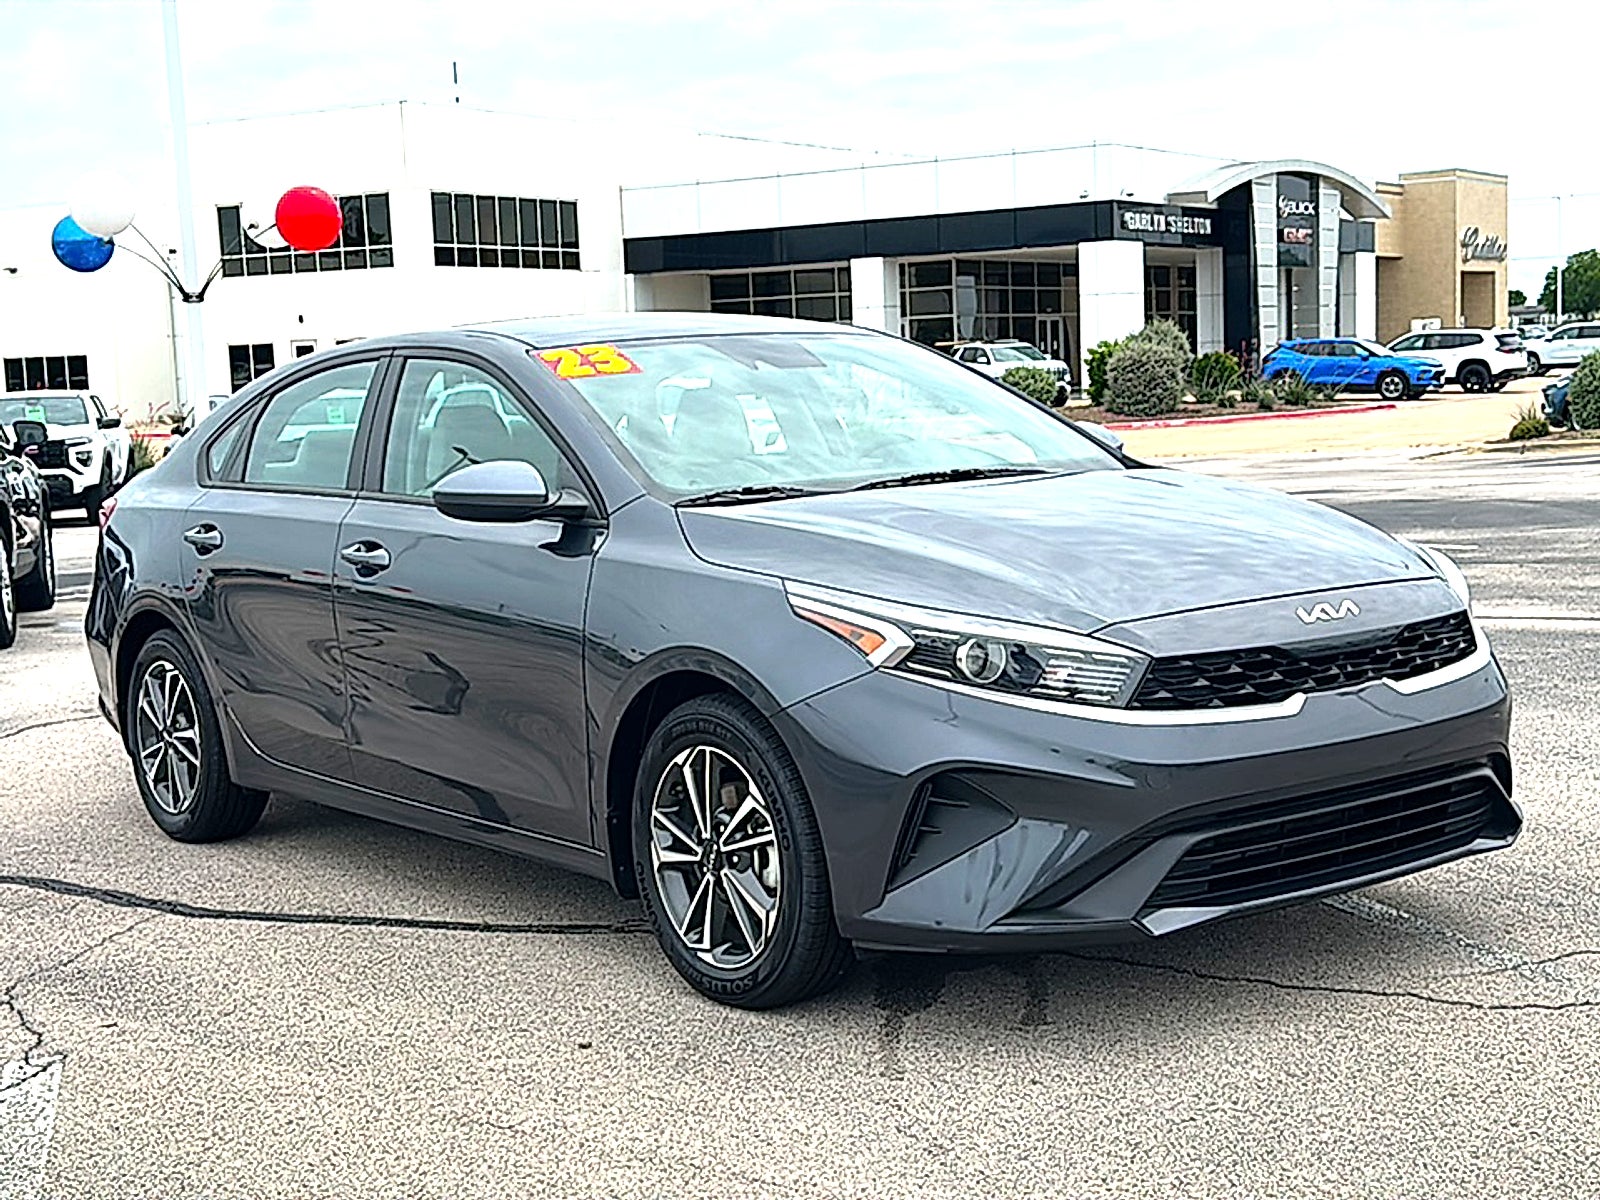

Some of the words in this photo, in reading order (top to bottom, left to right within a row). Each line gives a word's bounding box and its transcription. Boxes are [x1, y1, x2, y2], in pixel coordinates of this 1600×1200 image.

[1167, 215, 1212, 235] SHELTON
[540, 344, 632, 378] 23
[1295, 598, 1361, 625] KIA
